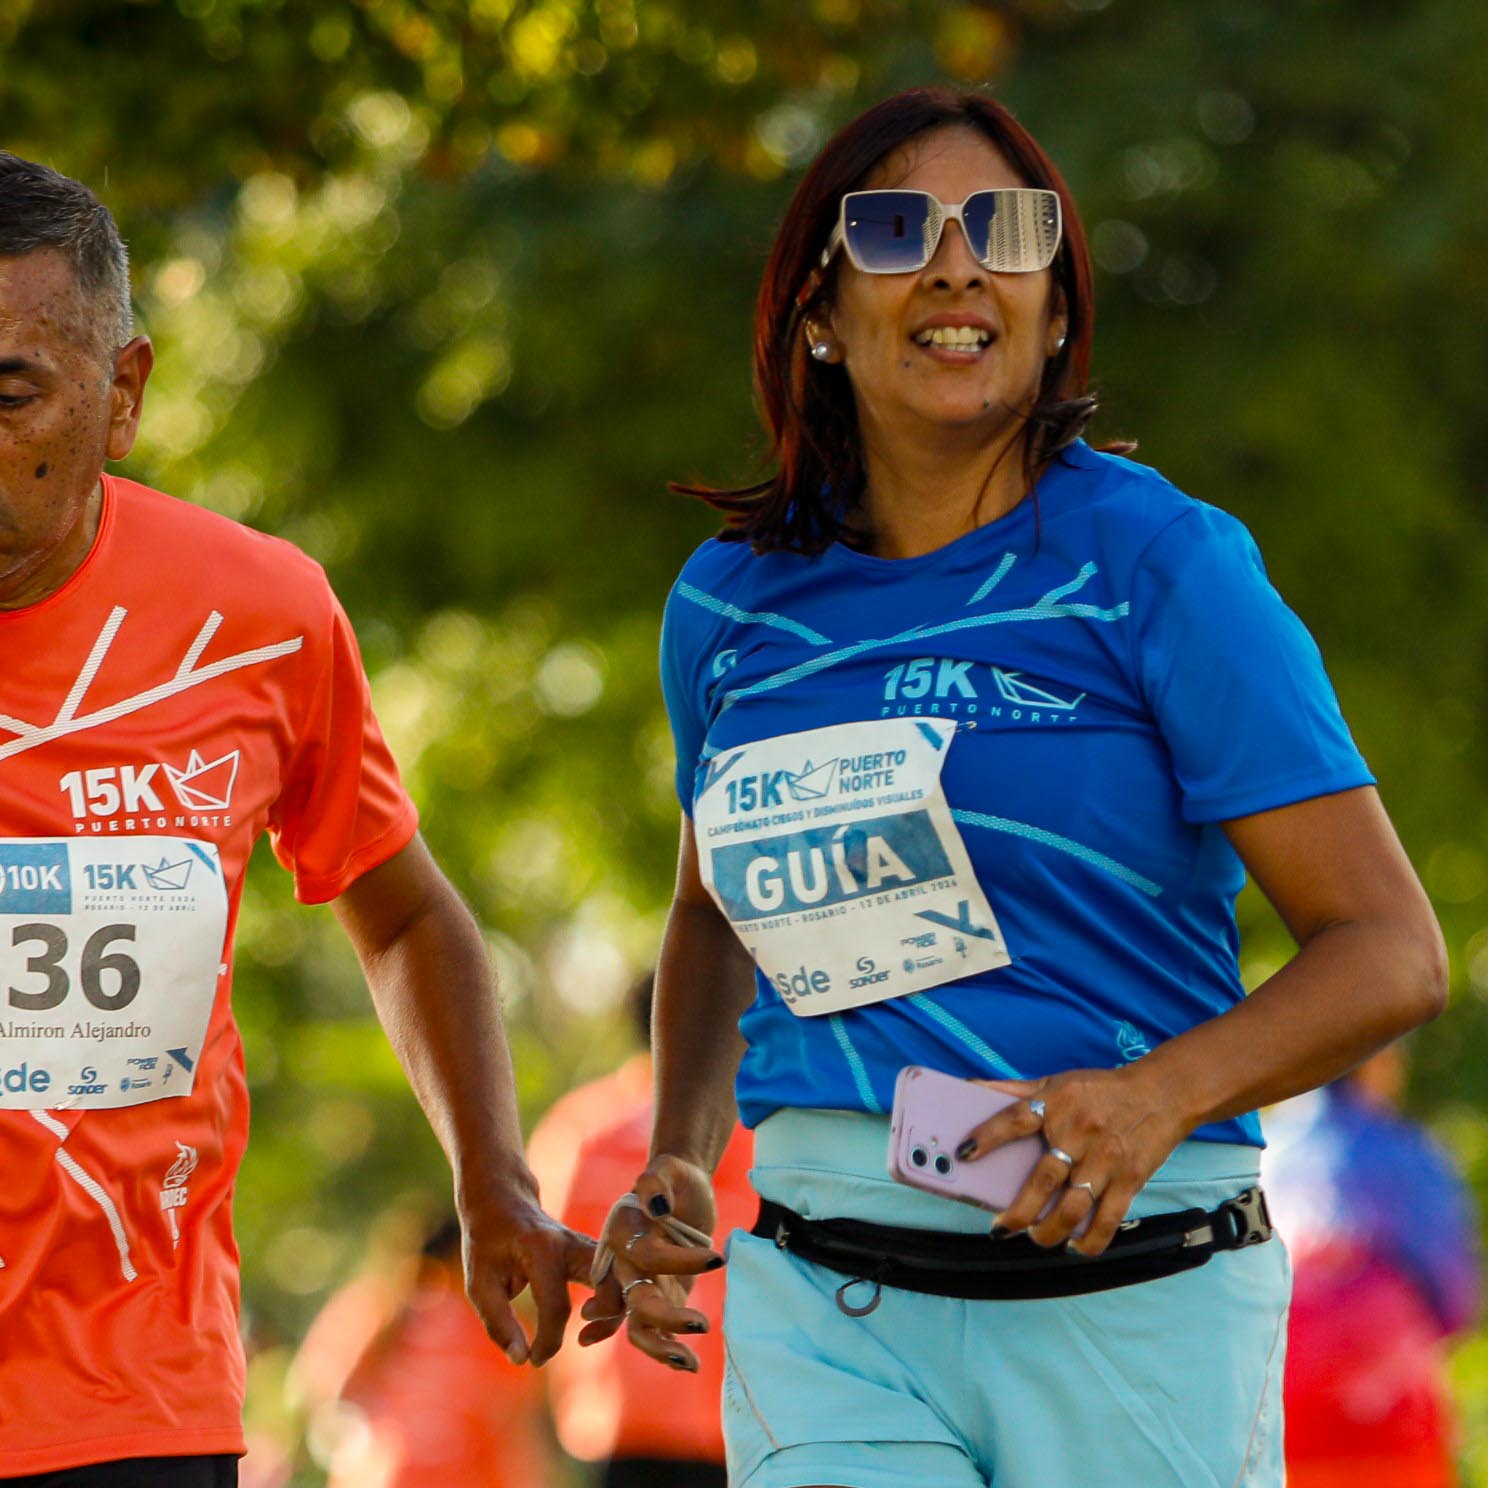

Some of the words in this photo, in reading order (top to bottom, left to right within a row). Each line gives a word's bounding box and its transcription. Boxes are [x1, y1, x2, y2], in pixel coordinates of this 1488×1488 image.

[883, 657, 978, 700] 15K
[881, 703, 977, 717] PUERTO
[839, 749, 906, 775] PUERTO
[59, 763, 165, 818] 15K
[725, 770, 784, 815] 15K
[839, 769, 894, 794] NORTE
[75, 817, 167, 833] PUERTO
[175, 815, 232, 828] NORTE
[7, 863, 63, 891] 10K
[83, 863, 138, 890] 15K
[745, 825, 916, 912] GUÍA
[761, 917, 792, 930] NORTE
[801, 905, 847, 923] ROSARIO
[876, 894, 891, 905] DE
[895, 886, 928, 901] ABRIL
[8, 922, 141, 1011] 36
[770, 965, 831, 1000] sde
[70, 1021, 151, 1042] Alejandro
